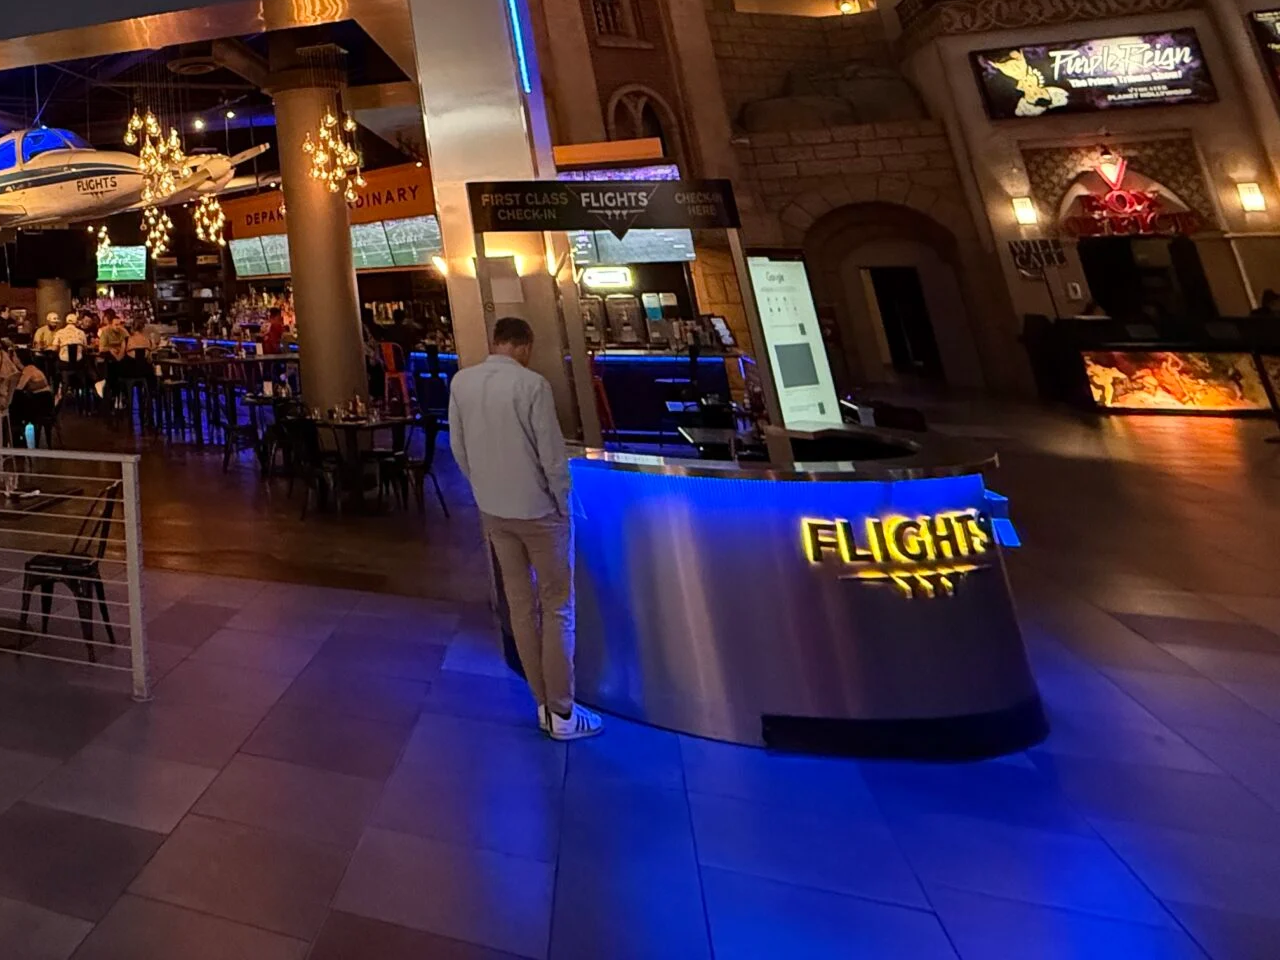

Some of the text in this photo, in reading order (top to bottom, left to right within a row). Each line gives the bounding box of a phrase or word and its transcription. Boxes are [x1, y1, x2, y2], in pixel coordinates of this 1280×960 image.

[1049, 43, 1193, 80] Purple Reign
[76, 176, 118, 192] FLIGHTS
[246, 185, 419, 226] DEPAR DINARY
[481, 191, 569, 207] FIRST CLASS
[581, 191, 649, 208] FLIGHTS
[497, 208, 557, 221] CHECK-IN
[687, 204, 717, 216] HERE
